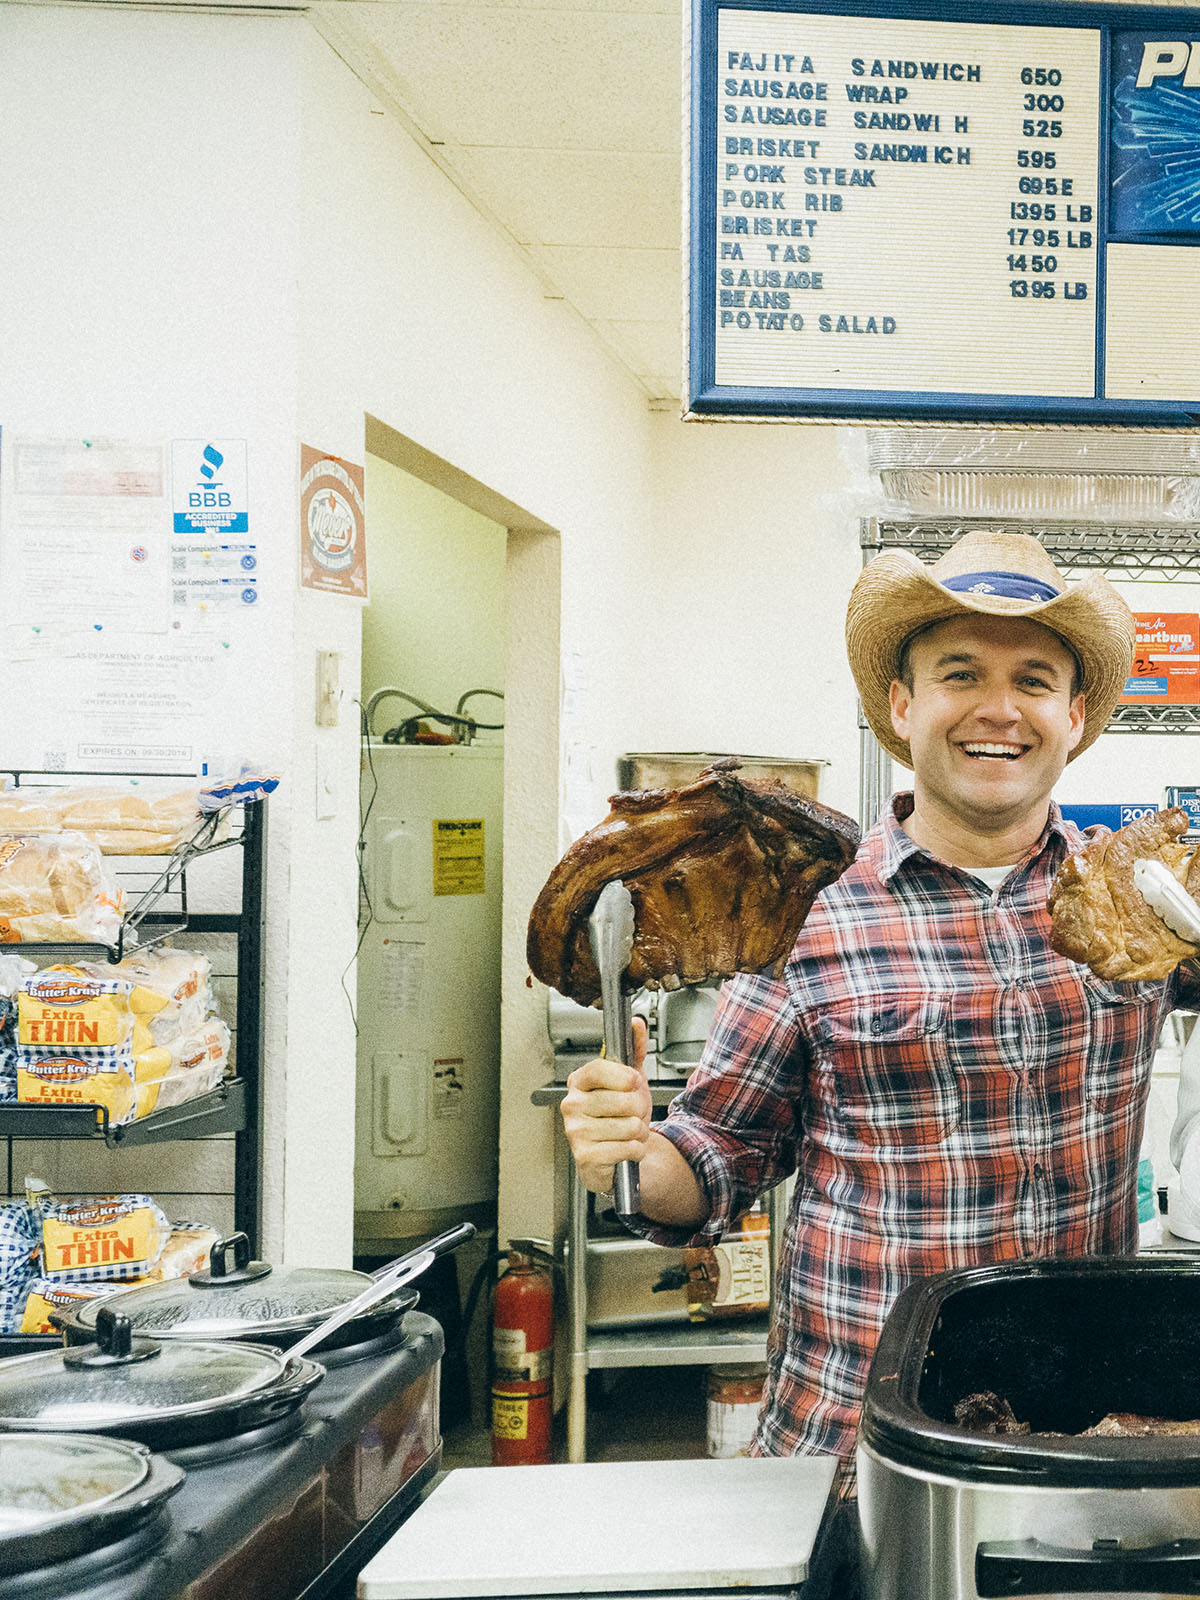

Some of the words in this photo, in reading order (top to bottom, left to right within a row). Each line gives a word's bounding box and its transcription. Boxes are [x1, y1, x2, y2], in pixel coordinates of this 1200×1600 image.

[727, 51, 815, 74] FAJITA
[851, 58, 982, 82] SANDWICH
[1020, 67, 1063, 87] 650
[724, 78, 828, 101] SAUSAGE
[846, 84, 909, 105] WRAP
[1023, 94, 1064, 113] 300
[724, 105, 827, 127] SAUSAGE
[1022, 120, 1064, 138] 525
[724, 136, 820, 159] BRISKET
[854, 142, 972, 166] SANDWICH
[1017, 150, 1057, 169] 595
[724, 163, 785, 183] PORK
[804, 167, 876, 188] STEAK
[722, 189, 785, 210] PORK
[805, 194, 844, 213] RIB
[1011, 201, 1056, 222] 1395
[1066, 205, 1093, 224] LB
[720, 215, 818, 237] BRISKET
[1007, 228, 1060, 248] 1795
[1067, 232, 1093, 249] LB
[1007, 254, 1058, 273] 1450
[720, 269, 824, 290] SAUSAGE
[1009, 280, 1056, 299] 1395
[1064, 282, 1088, 300] LB
[719, 291, 792, 310] BEANS
[720, 310, 804, 332] POTATO
[818, 315, 897, 335] SALAD
[188, 492, 232, 508] BBB
[1136, 631, 1192, 643] eartburn
[28, 987, 67, 998] Butter
[68, 986, 101, 997] Krust
[42, 1009, 85, 1020] Extra
[27, 1021, 99, 1042] THIN
[27, 1064, 65, 1074] Butter
[66, 1064, 98, 1075] Krust
[40, 1086, 82, 1098] Extra
[57, 1210, 98, 1223] Butter
[99, 1202, 134, 1216] Krust
[73, 1229, 119, 1243] Extra
[56, 1237, 135, 1267] THIN
